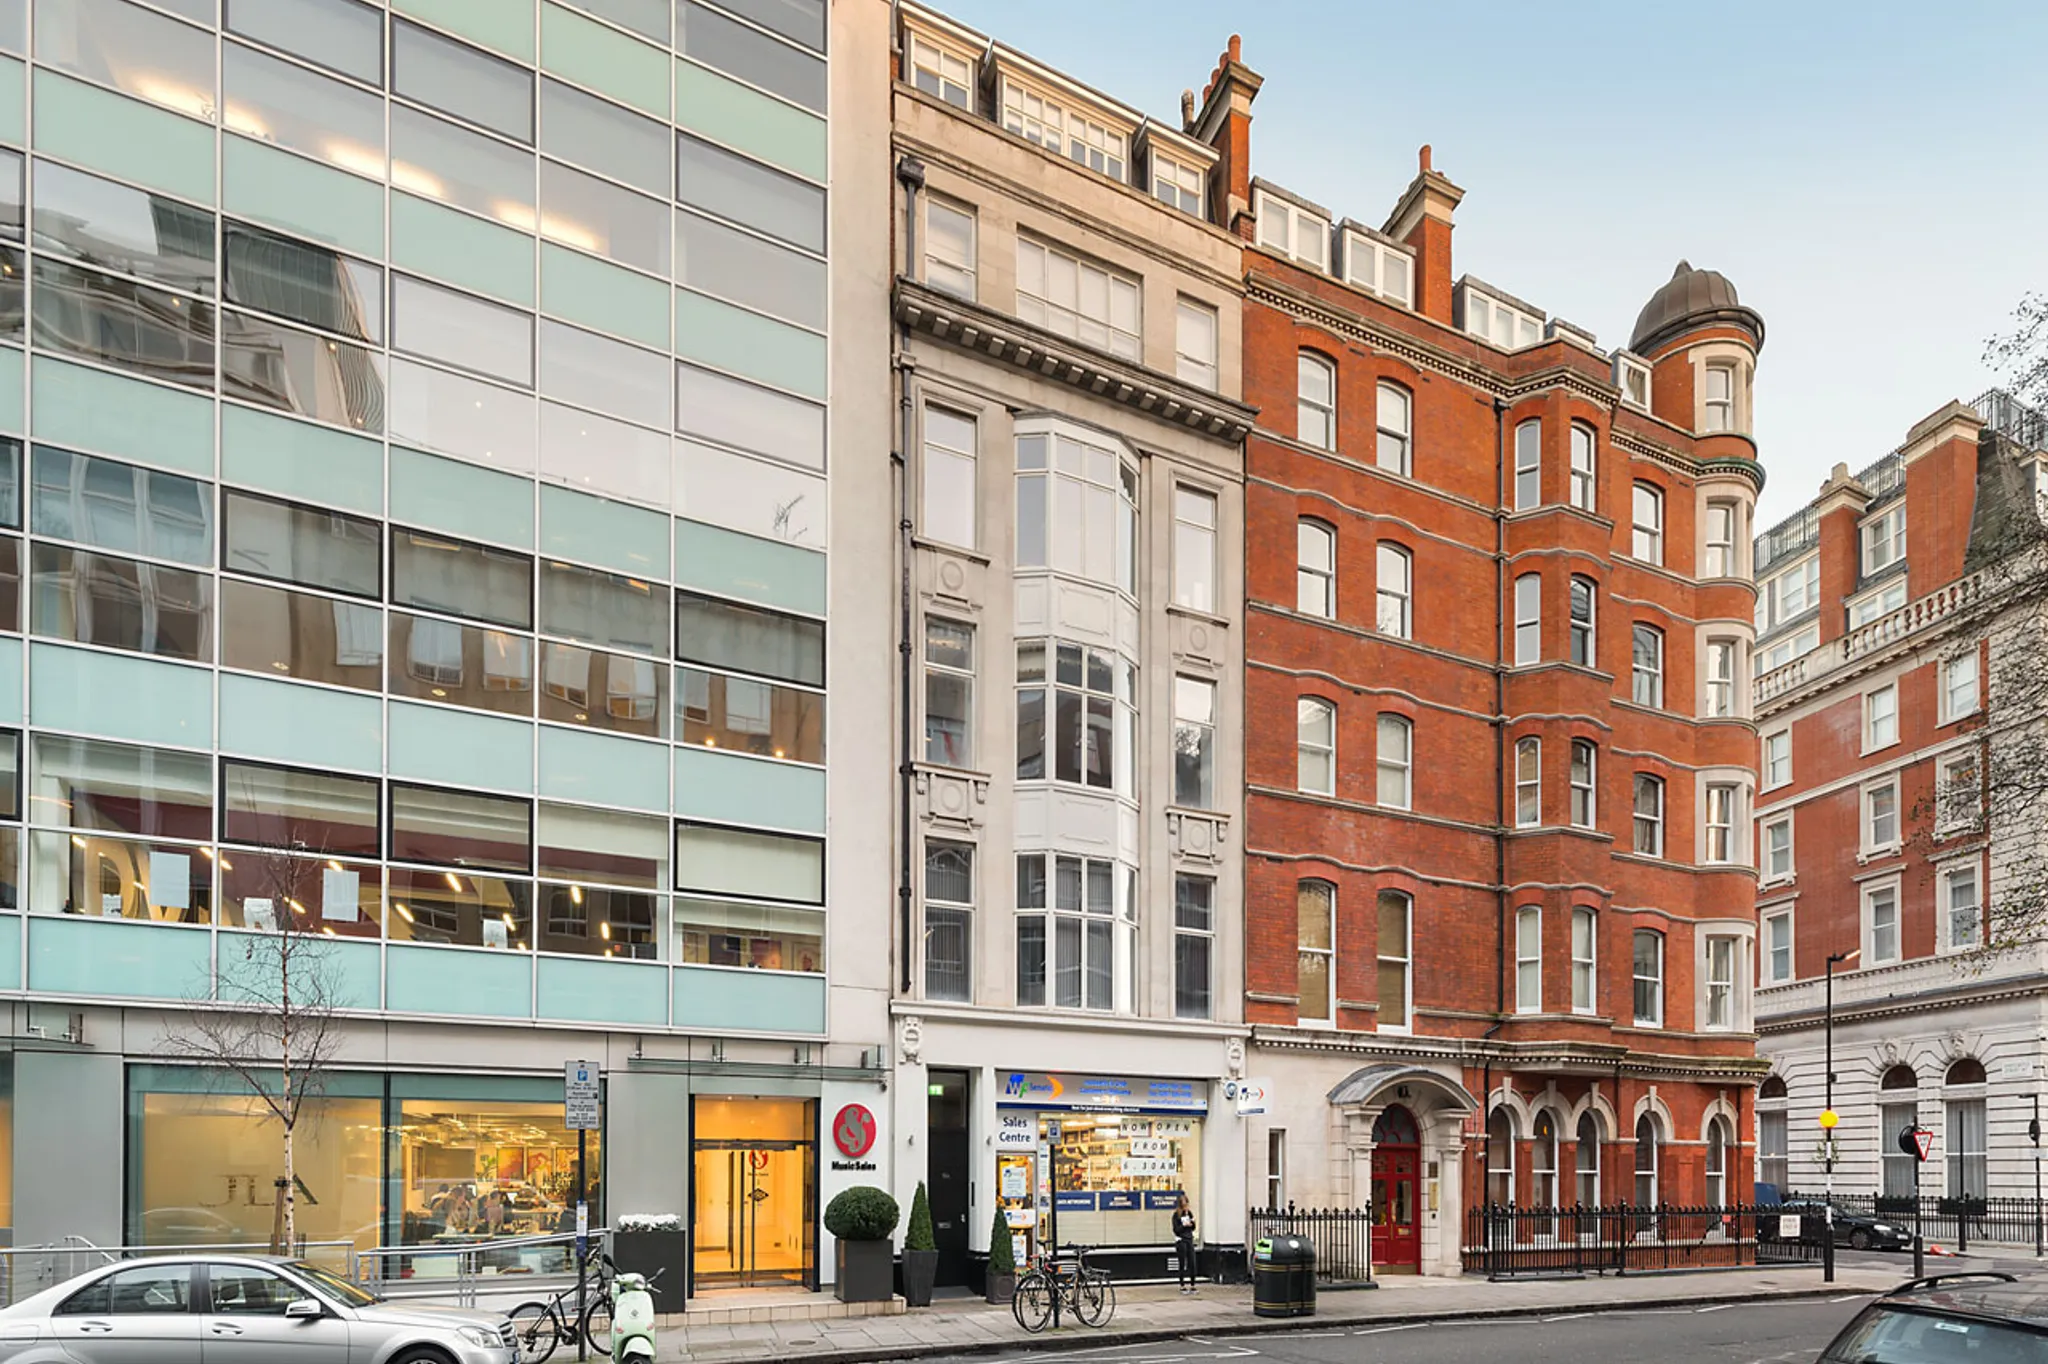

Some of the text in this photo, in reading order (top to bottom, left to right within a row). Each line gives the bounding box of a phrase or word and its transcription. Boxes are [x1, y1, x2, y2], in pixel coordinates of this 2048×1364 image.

[1003, 1116, 1027, 1128] Sales
[1122, 1122, 1189, 1132] NOW OPEN
[999, 1132, 1031, 1143] Centre
[1133, 1141, 1168, 1150] FROM
[832, 1160, 877, 1172] Music Sales
